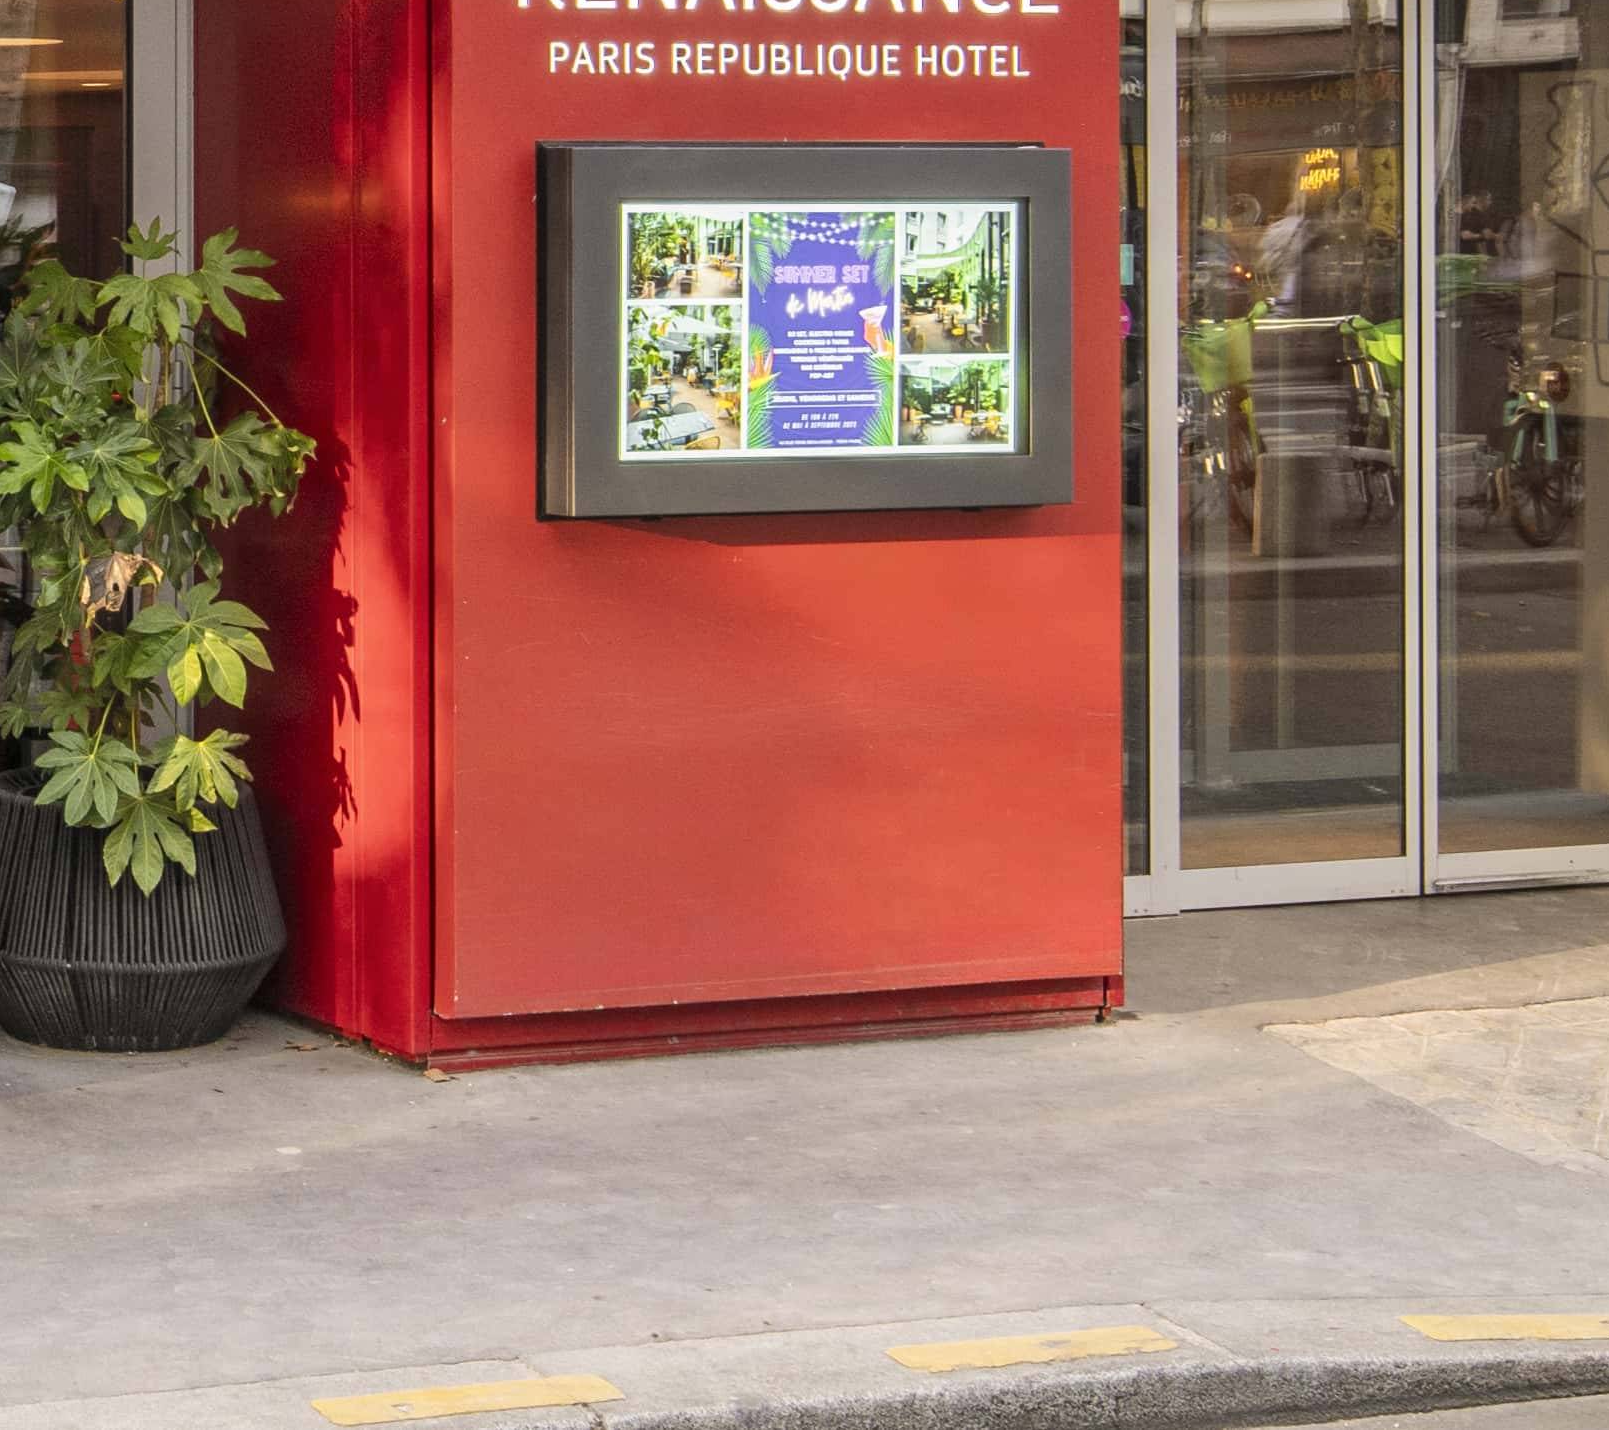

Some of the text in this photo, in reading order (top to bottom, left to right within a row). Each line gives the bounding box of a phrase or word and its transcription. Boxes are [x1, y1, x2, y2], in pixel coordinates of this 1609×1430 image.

[548, 41, 1031, 82] PARIS REPUBLIQUE HOTEL
